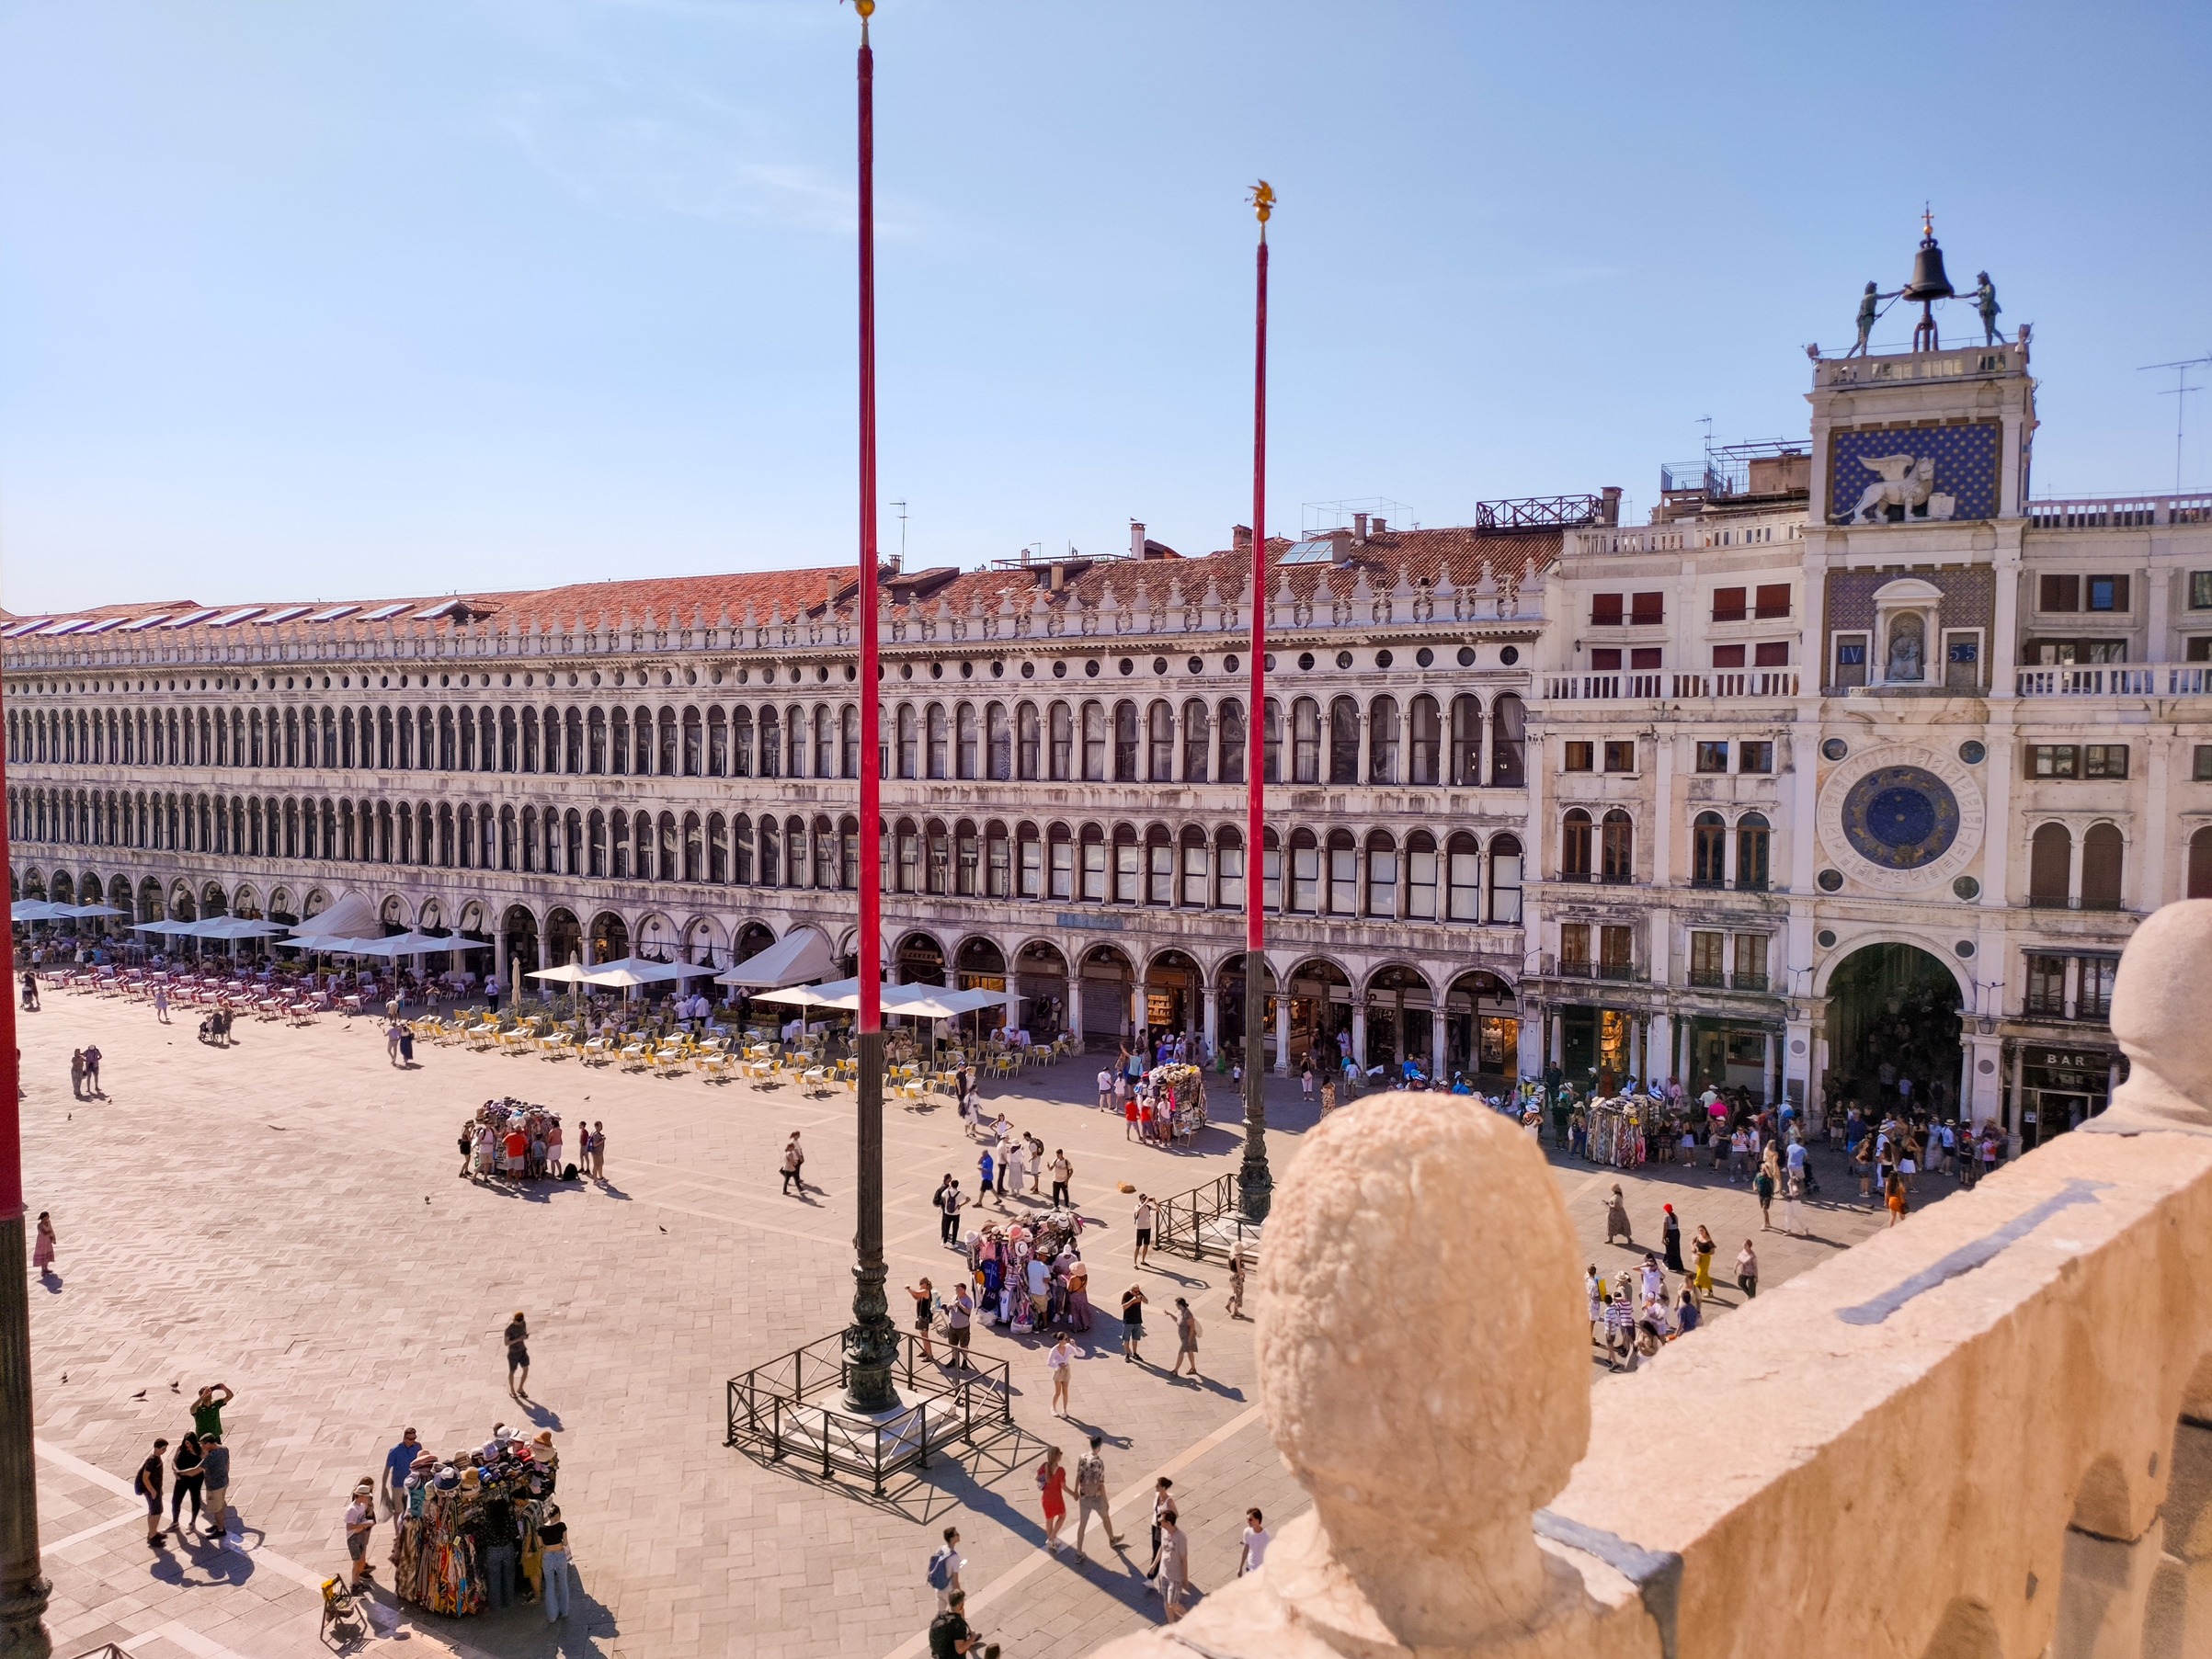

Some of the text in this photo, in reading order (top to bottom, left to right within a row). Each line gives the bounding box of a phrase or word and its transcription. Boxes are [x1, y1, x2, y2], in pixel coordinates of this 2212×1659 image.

[1841, 646, 1861, 664] IV
[1949, 644, 1977, 662] 55
[2047, 1053, 2085, 1066] BAR
